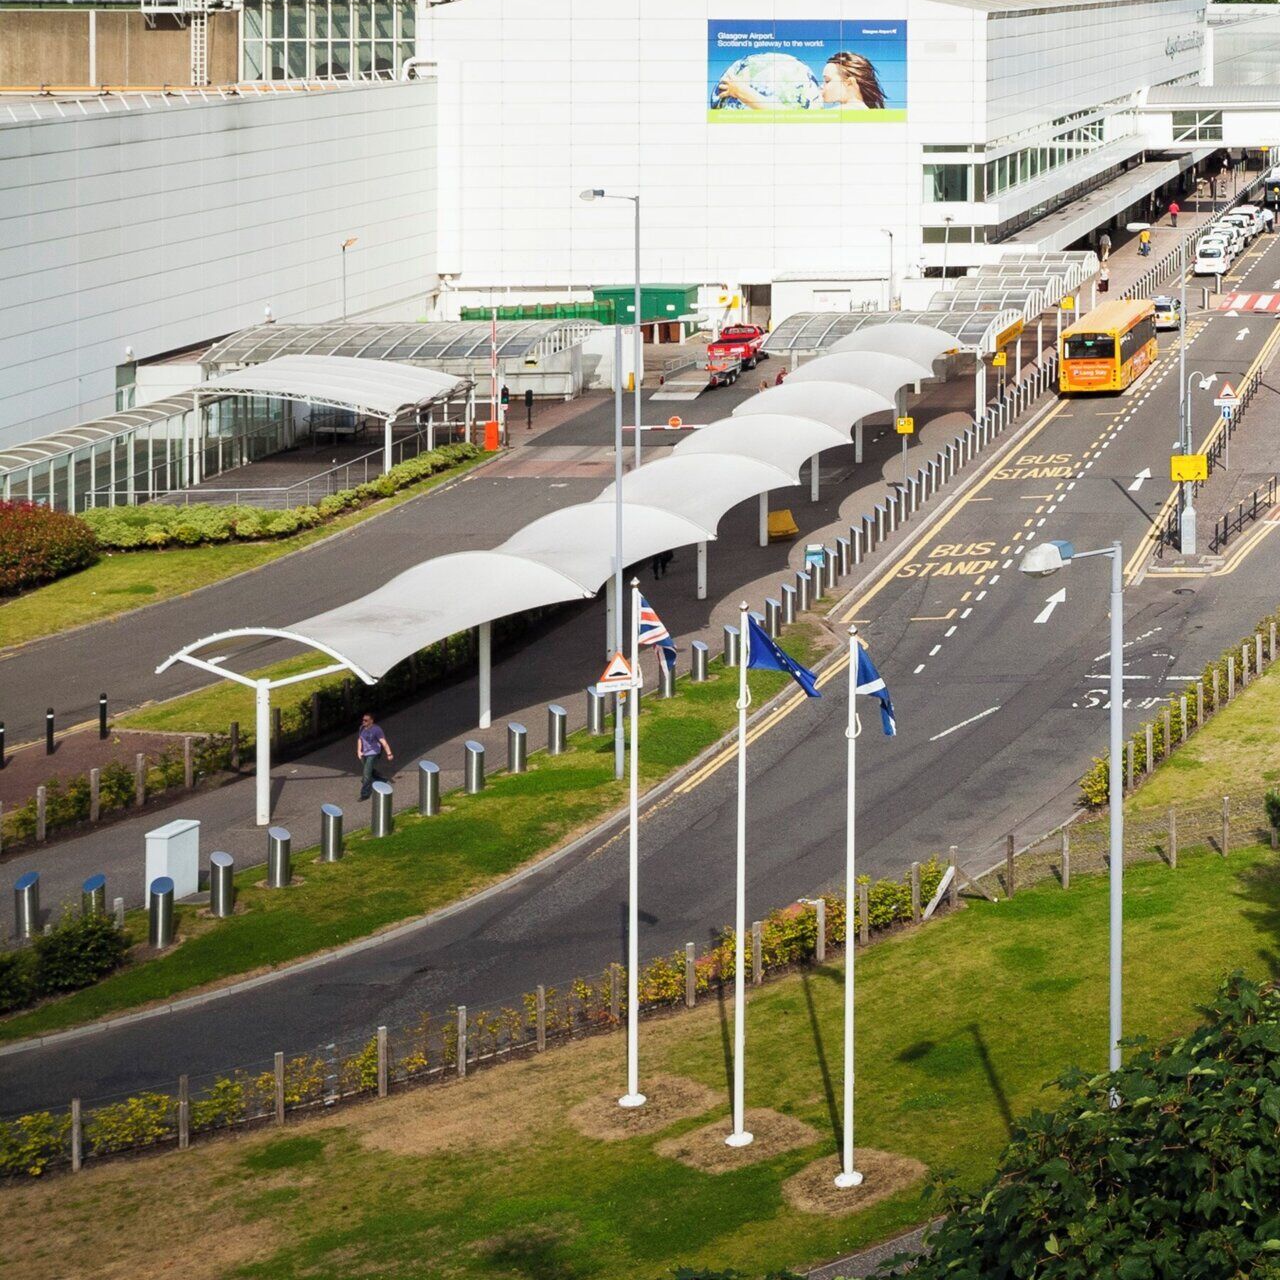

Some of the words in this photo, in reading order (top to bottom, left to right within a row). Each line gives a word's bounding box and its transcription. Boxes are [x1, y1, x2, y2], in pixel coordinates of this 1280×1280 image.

[717, 32, 748, 40] Glasgow
[1015, 453, 1073, 465] BUS
[991, 467, 1069, 480] STAND
[928, 542, 996, 558] BUS
[896, 560, 993, 578] STAND
